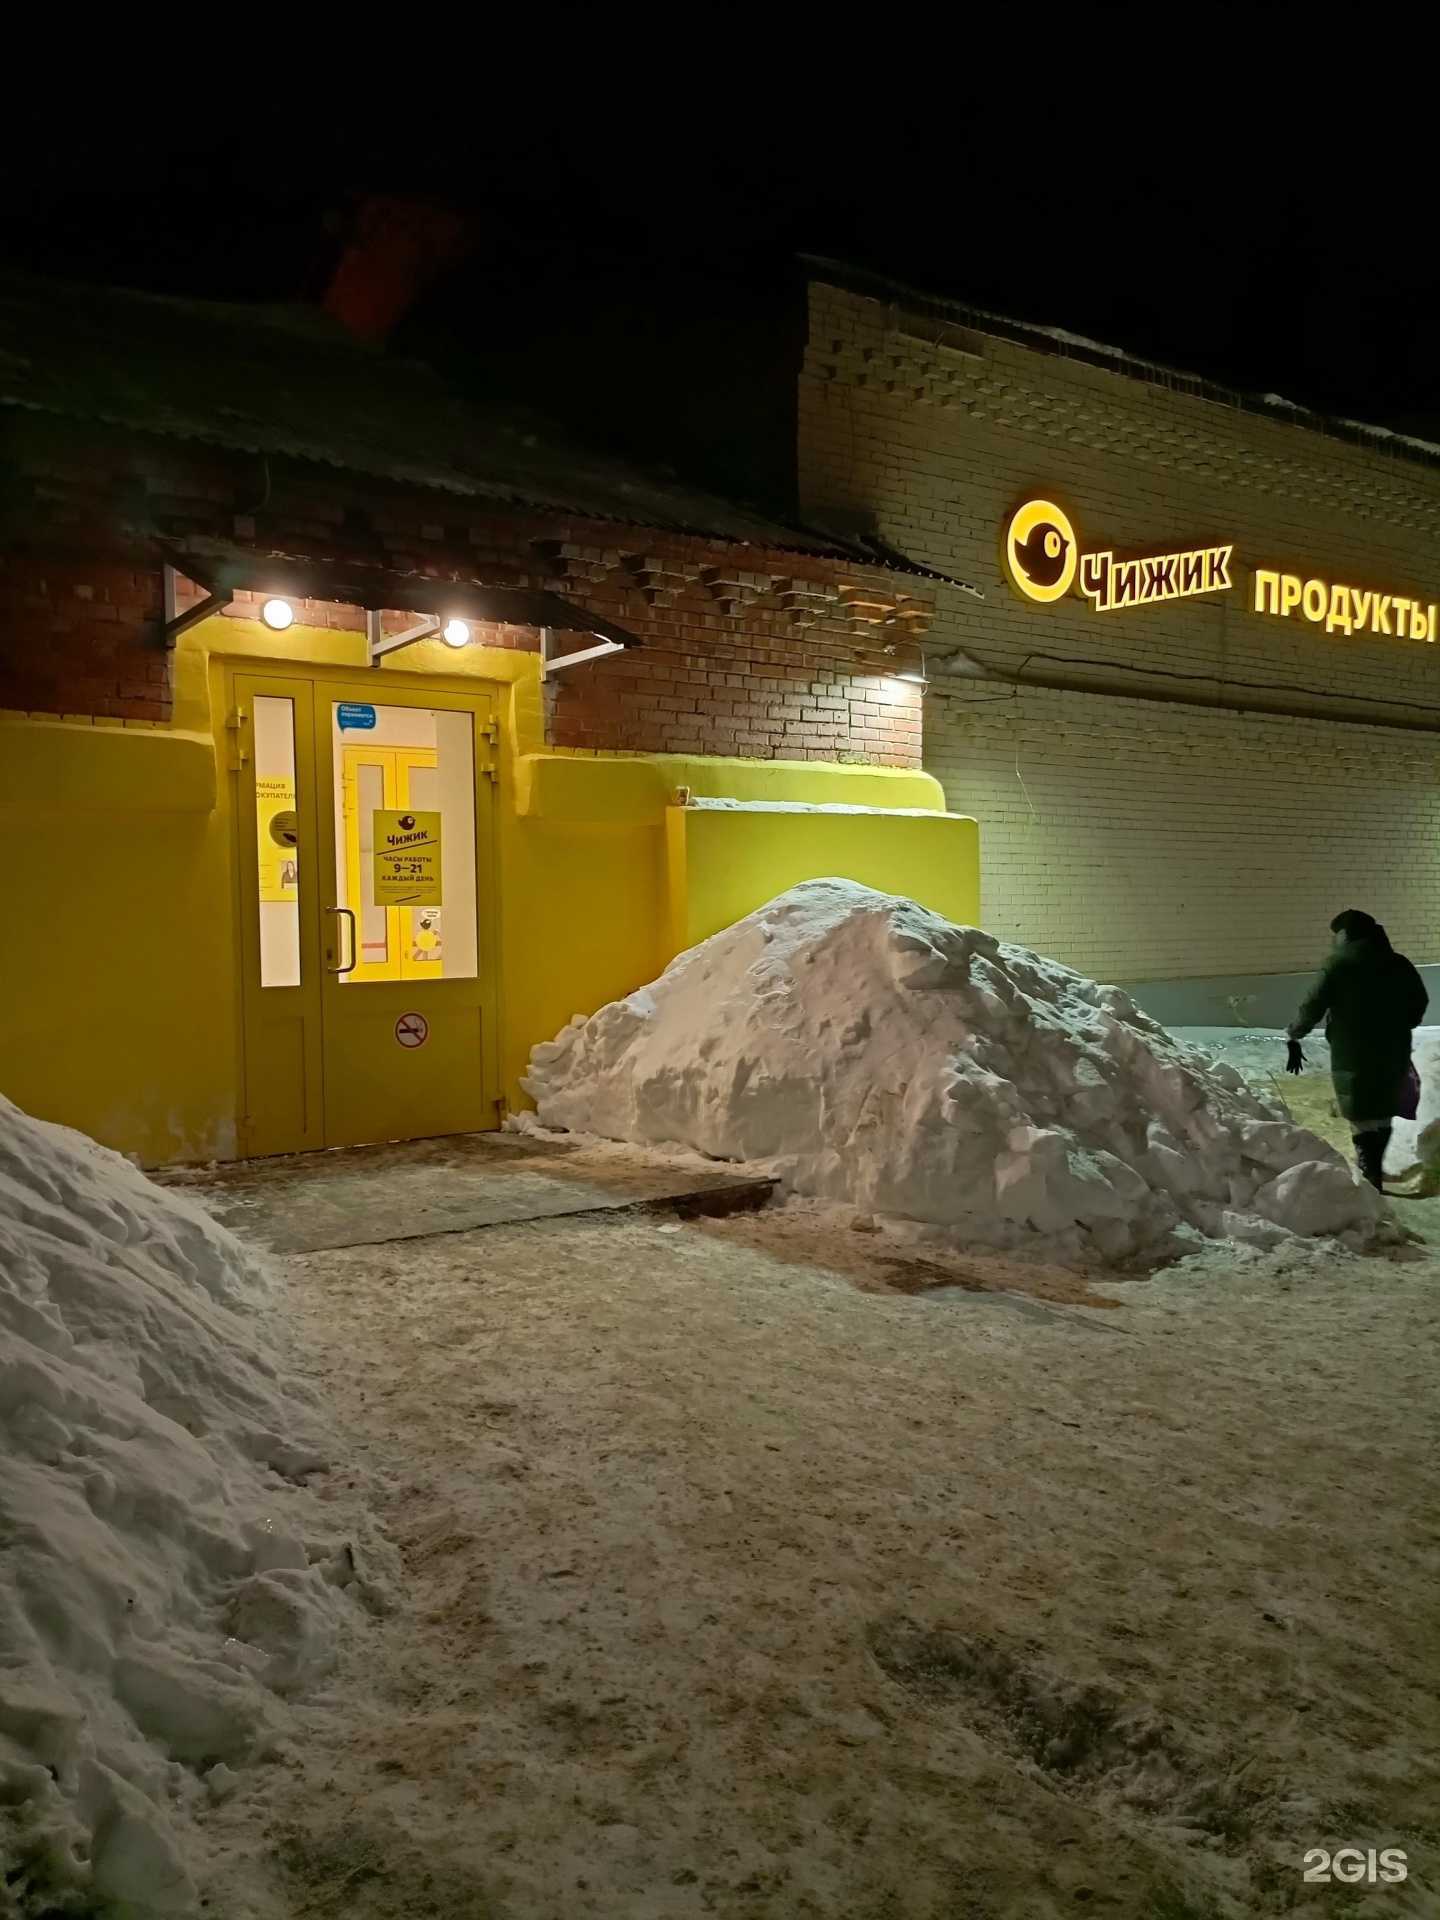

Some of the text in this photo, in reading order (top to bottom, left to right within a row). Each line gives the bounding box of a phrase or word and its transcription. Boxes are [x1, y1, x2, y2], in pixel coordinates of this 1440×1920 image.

[1079, 545, 1233, 612] Чижик
[1254, 569, 1438, 643] ПРОДУКТЫ
[387, 830, 428, 846] Чижик
[382, 873, 414, 882] КАЖДЫЙ
